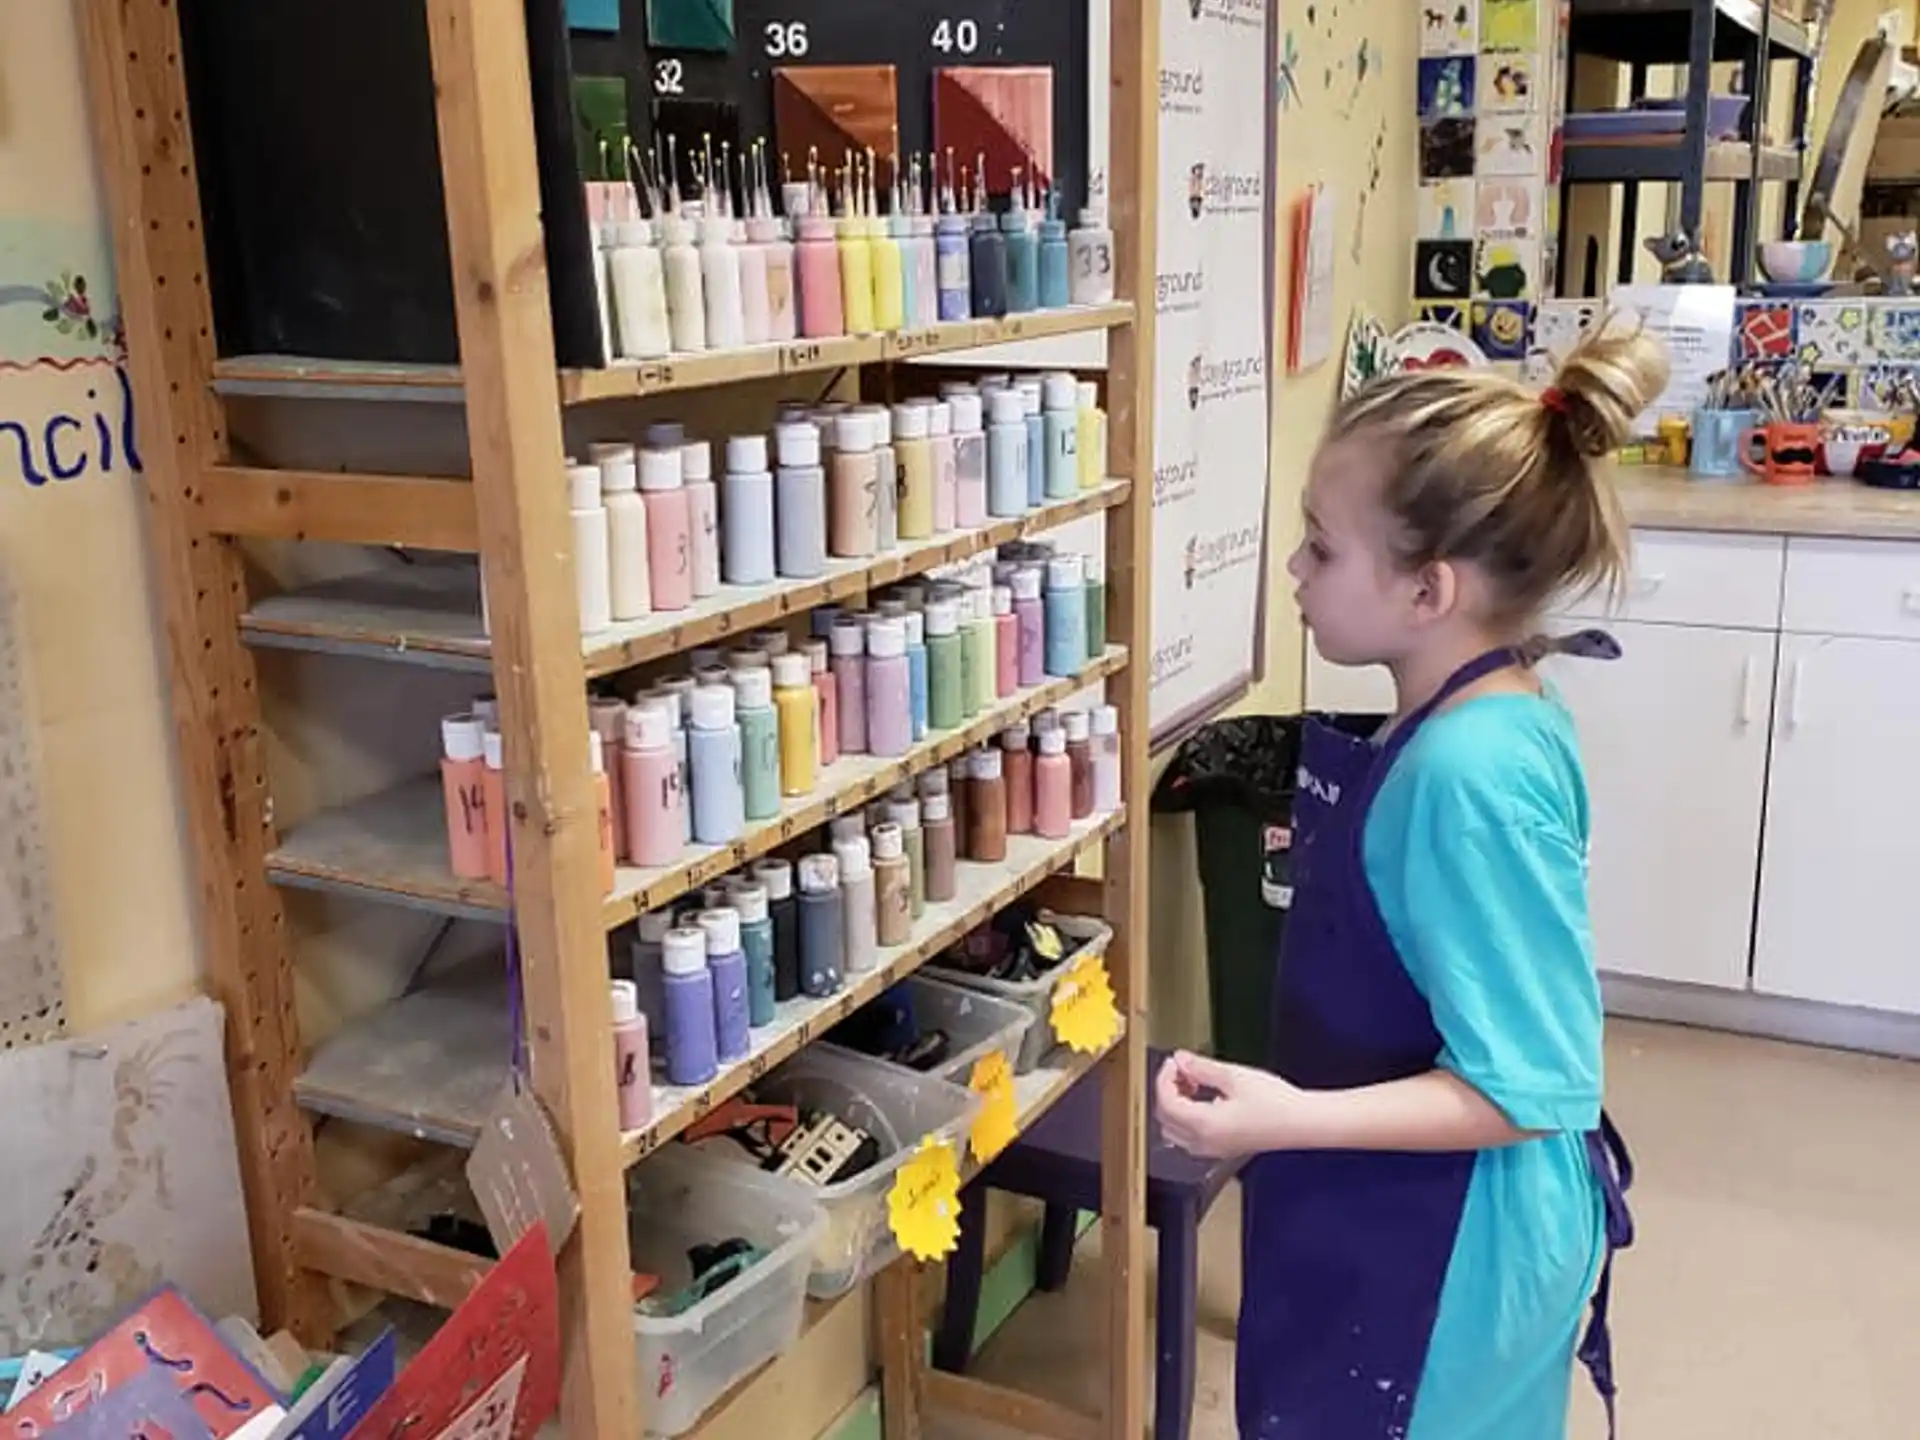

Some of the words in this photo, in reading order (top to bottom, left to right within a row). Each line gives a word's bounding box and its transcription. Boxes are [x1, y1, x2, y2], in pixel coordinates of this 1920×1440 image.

[764, 22, 808, 56] 36
[931, 20, 978, 54] 40
[655, 58, 684, 93] 32
